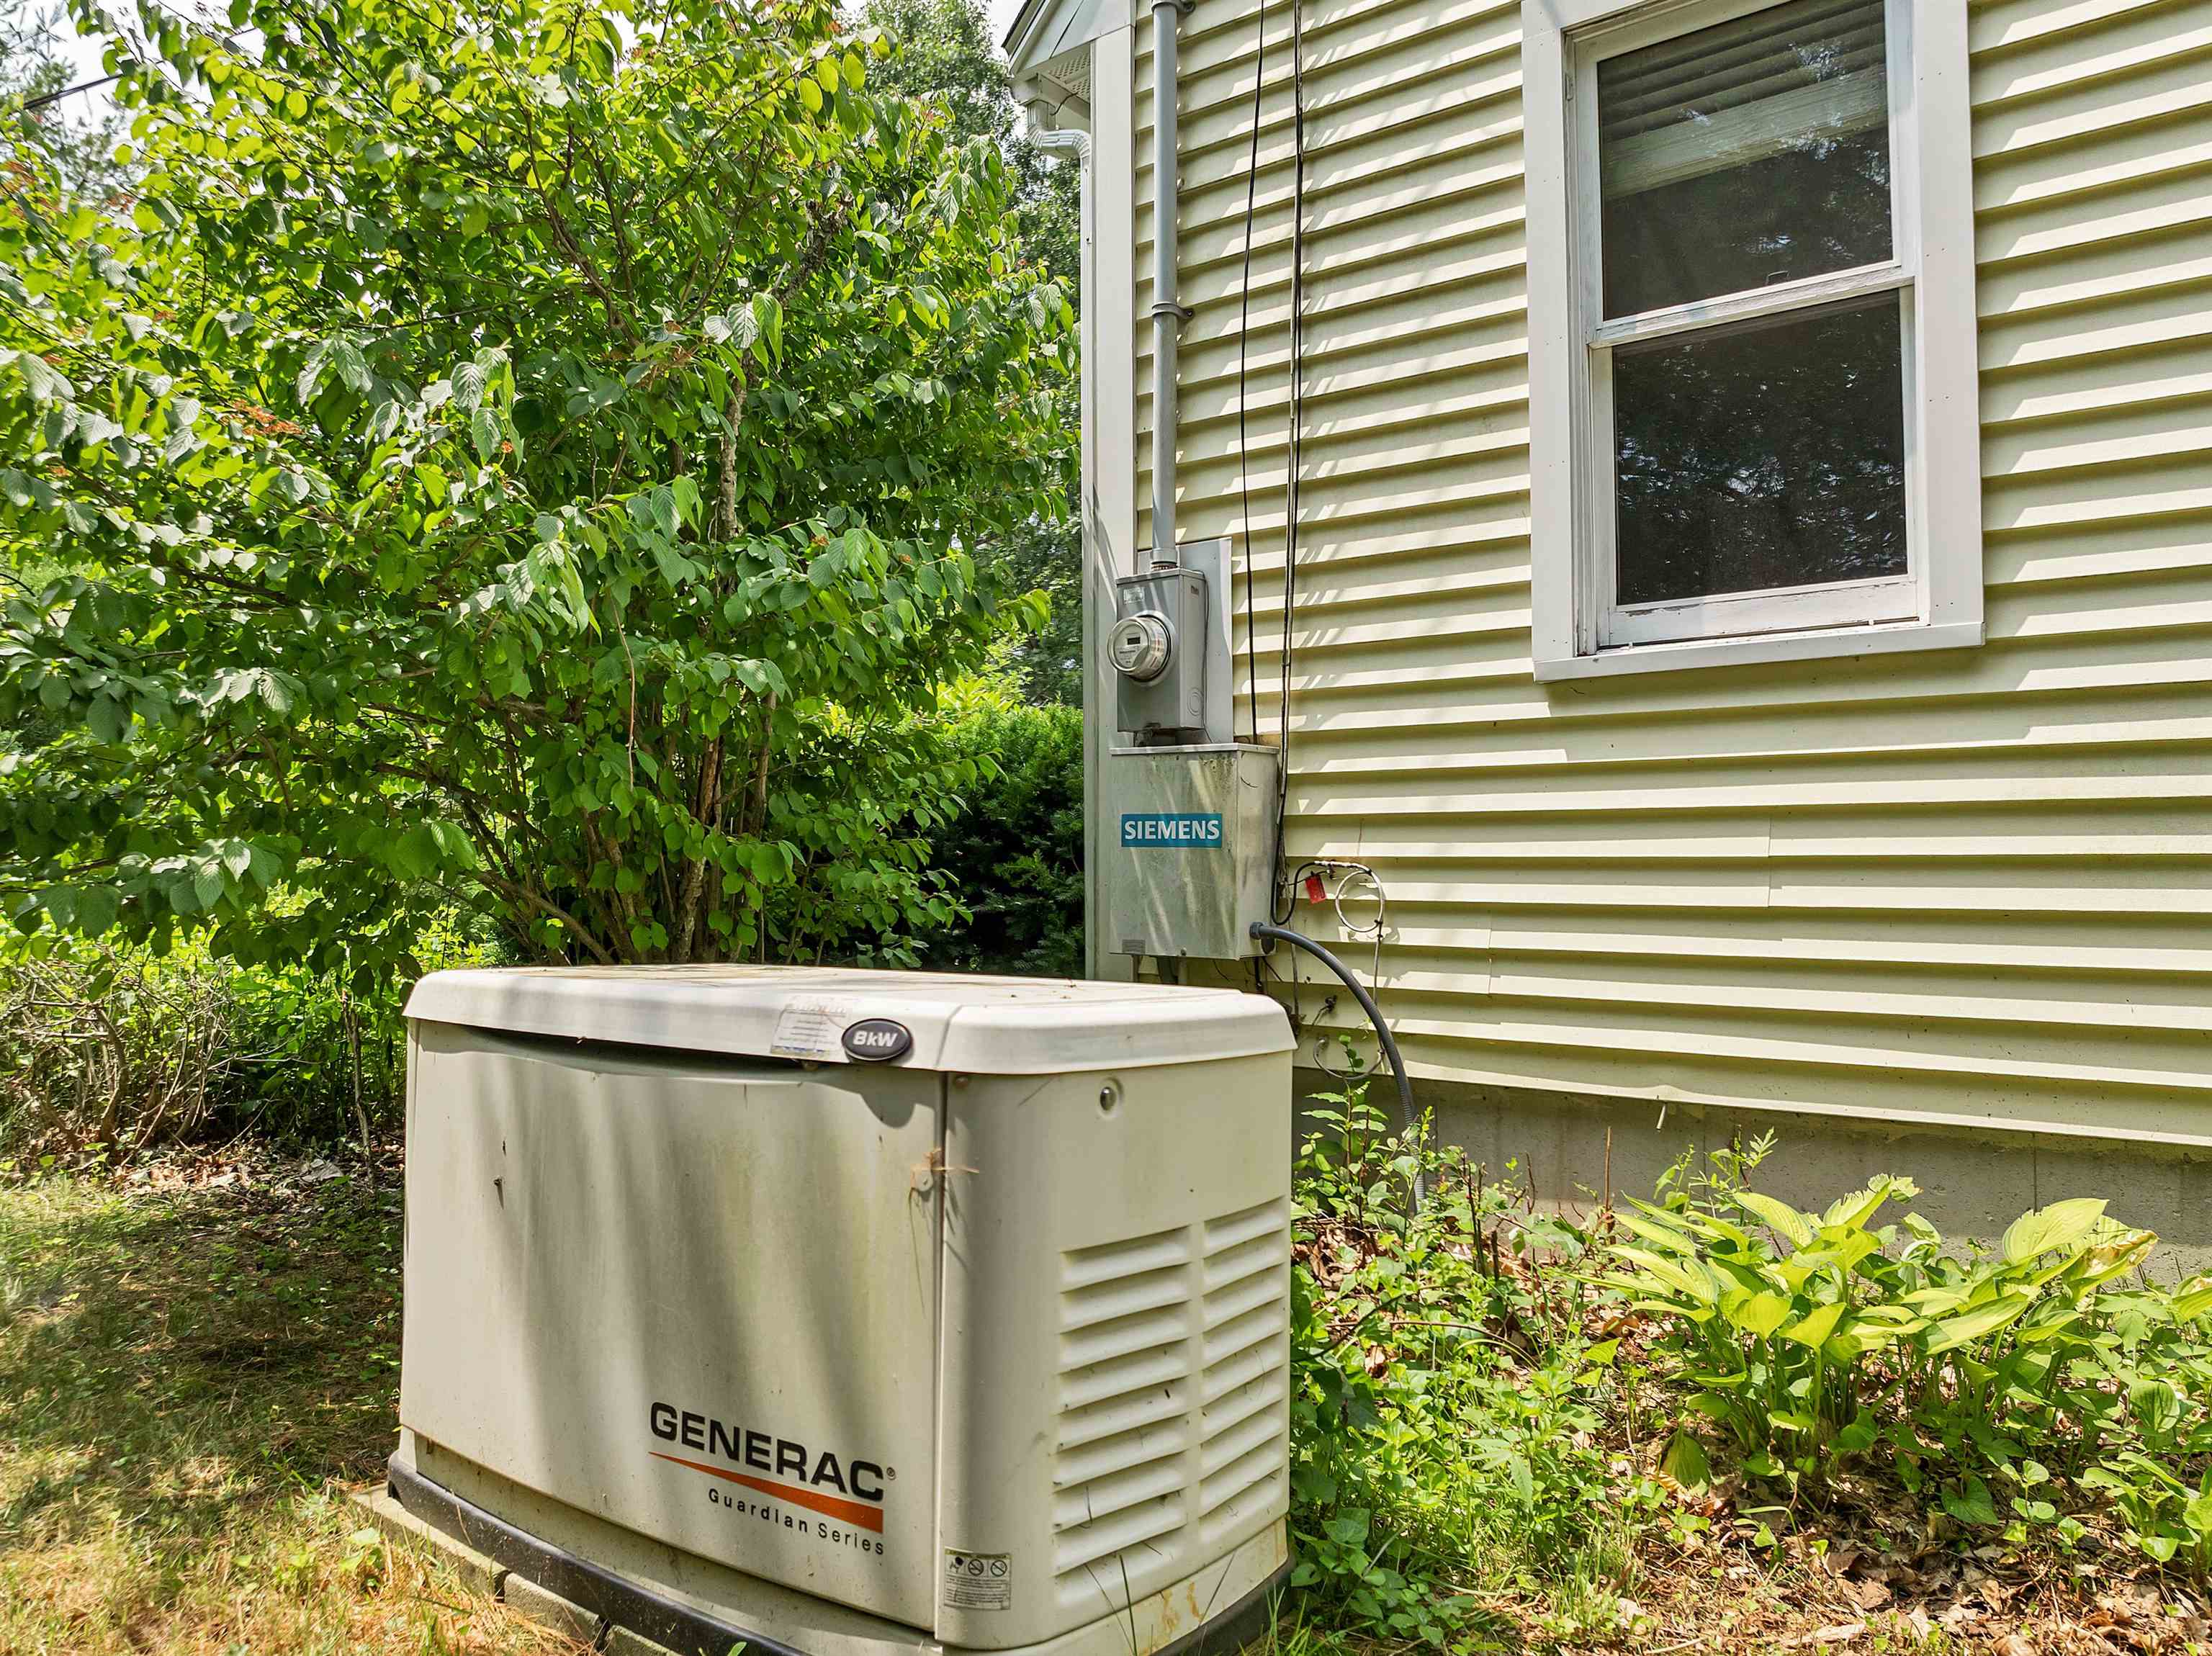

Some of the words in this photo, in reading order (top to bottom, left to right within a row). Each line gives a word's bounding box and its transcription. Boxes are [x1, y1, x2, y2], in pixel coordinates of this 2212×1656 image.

[1124, 819, 1220, 840] SIEMENS
[853, 1030, 898, 1047] 8kW
[650, 1401, 884, 1503] GENERAC
[708, 1488, 808, 1533] Guardian
[817, 1523, 884, 1555] Series
